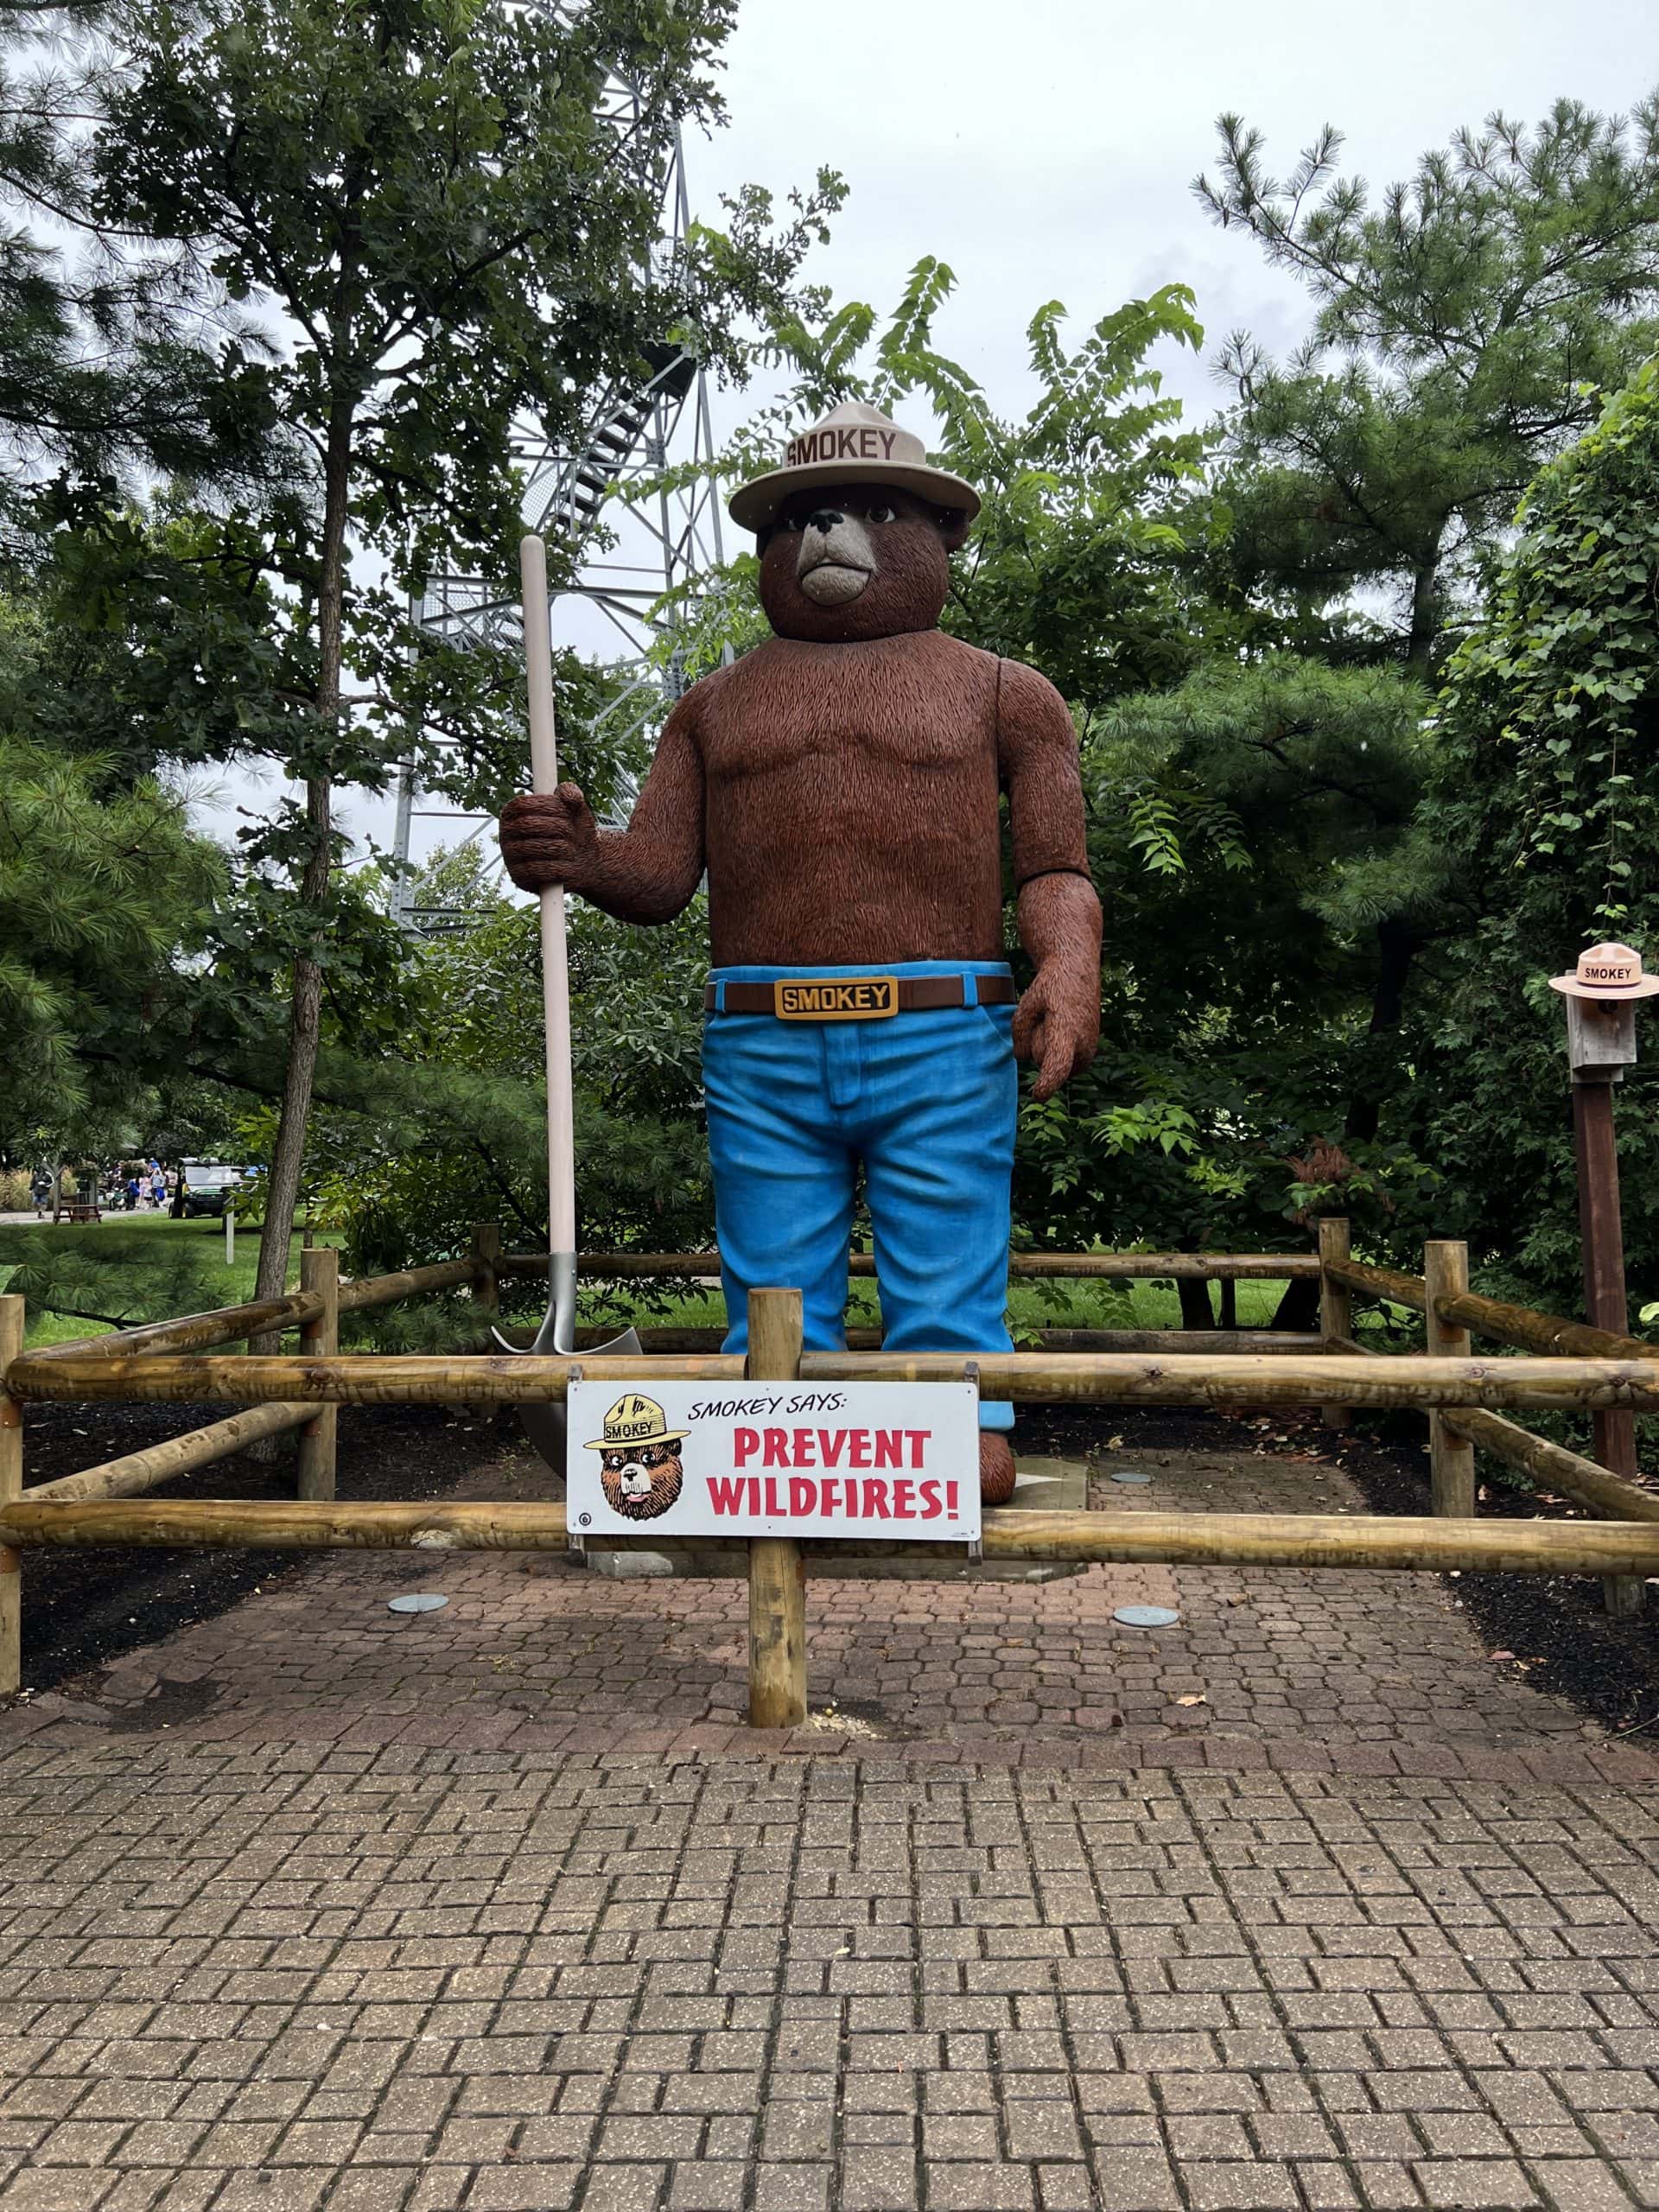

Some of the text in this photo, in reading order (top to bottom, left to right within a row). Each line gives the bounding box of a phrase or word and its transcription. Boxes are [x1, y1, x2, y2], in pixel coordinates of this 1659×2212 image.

[787, 429, 897, 467] SMOKEY
[1585, 967, 1631, 979] SMOKEY
[784, 984, 888, 1011] SMOKEY
[688, 1393, 848, 1421] SMOKEY SAYS:
[606, 1421, 652, 1439] SMOKEY
[733, 1427, 932, 1469] PREVENT
[705, 1476, 960, 1520] WILDFIRES!
